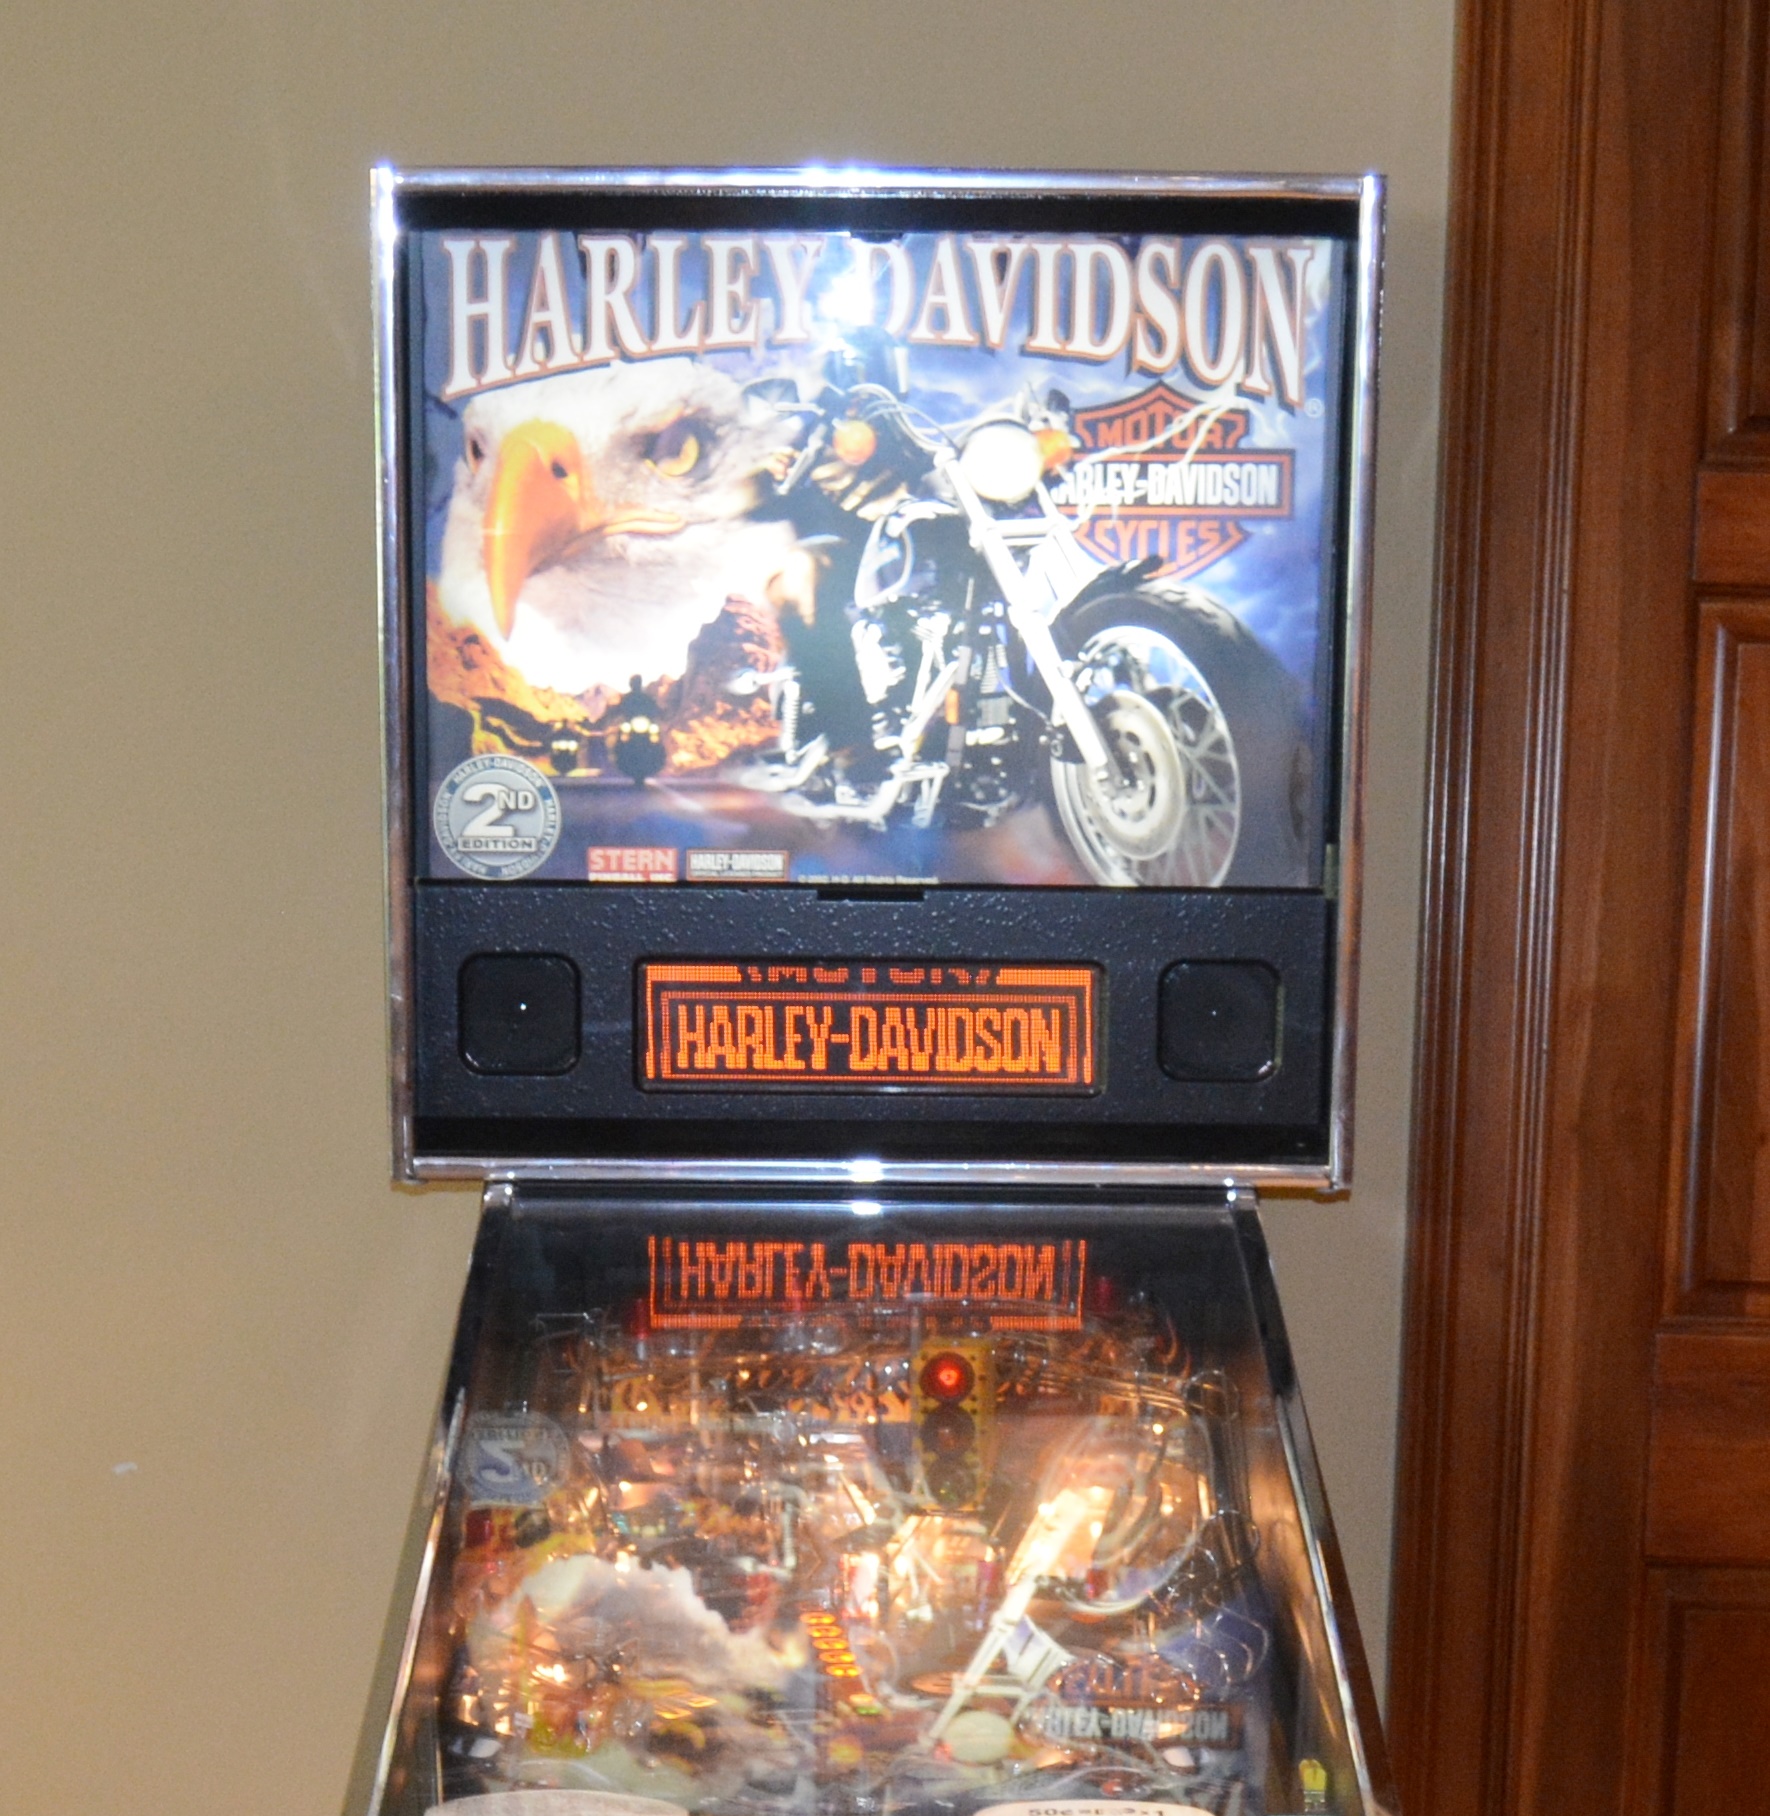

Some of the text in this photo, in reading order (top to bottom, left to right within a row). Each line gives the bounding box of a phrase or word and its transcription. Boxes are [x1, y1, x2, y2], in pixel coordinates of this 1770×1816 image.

[442, 232, 826, 399] HARLEY
[462, 839, 533, 850] EDITION
[590, 849, 675, 871] STERN
[677, 1004, 1062, 1072] HARLEY-DAVIDSON
